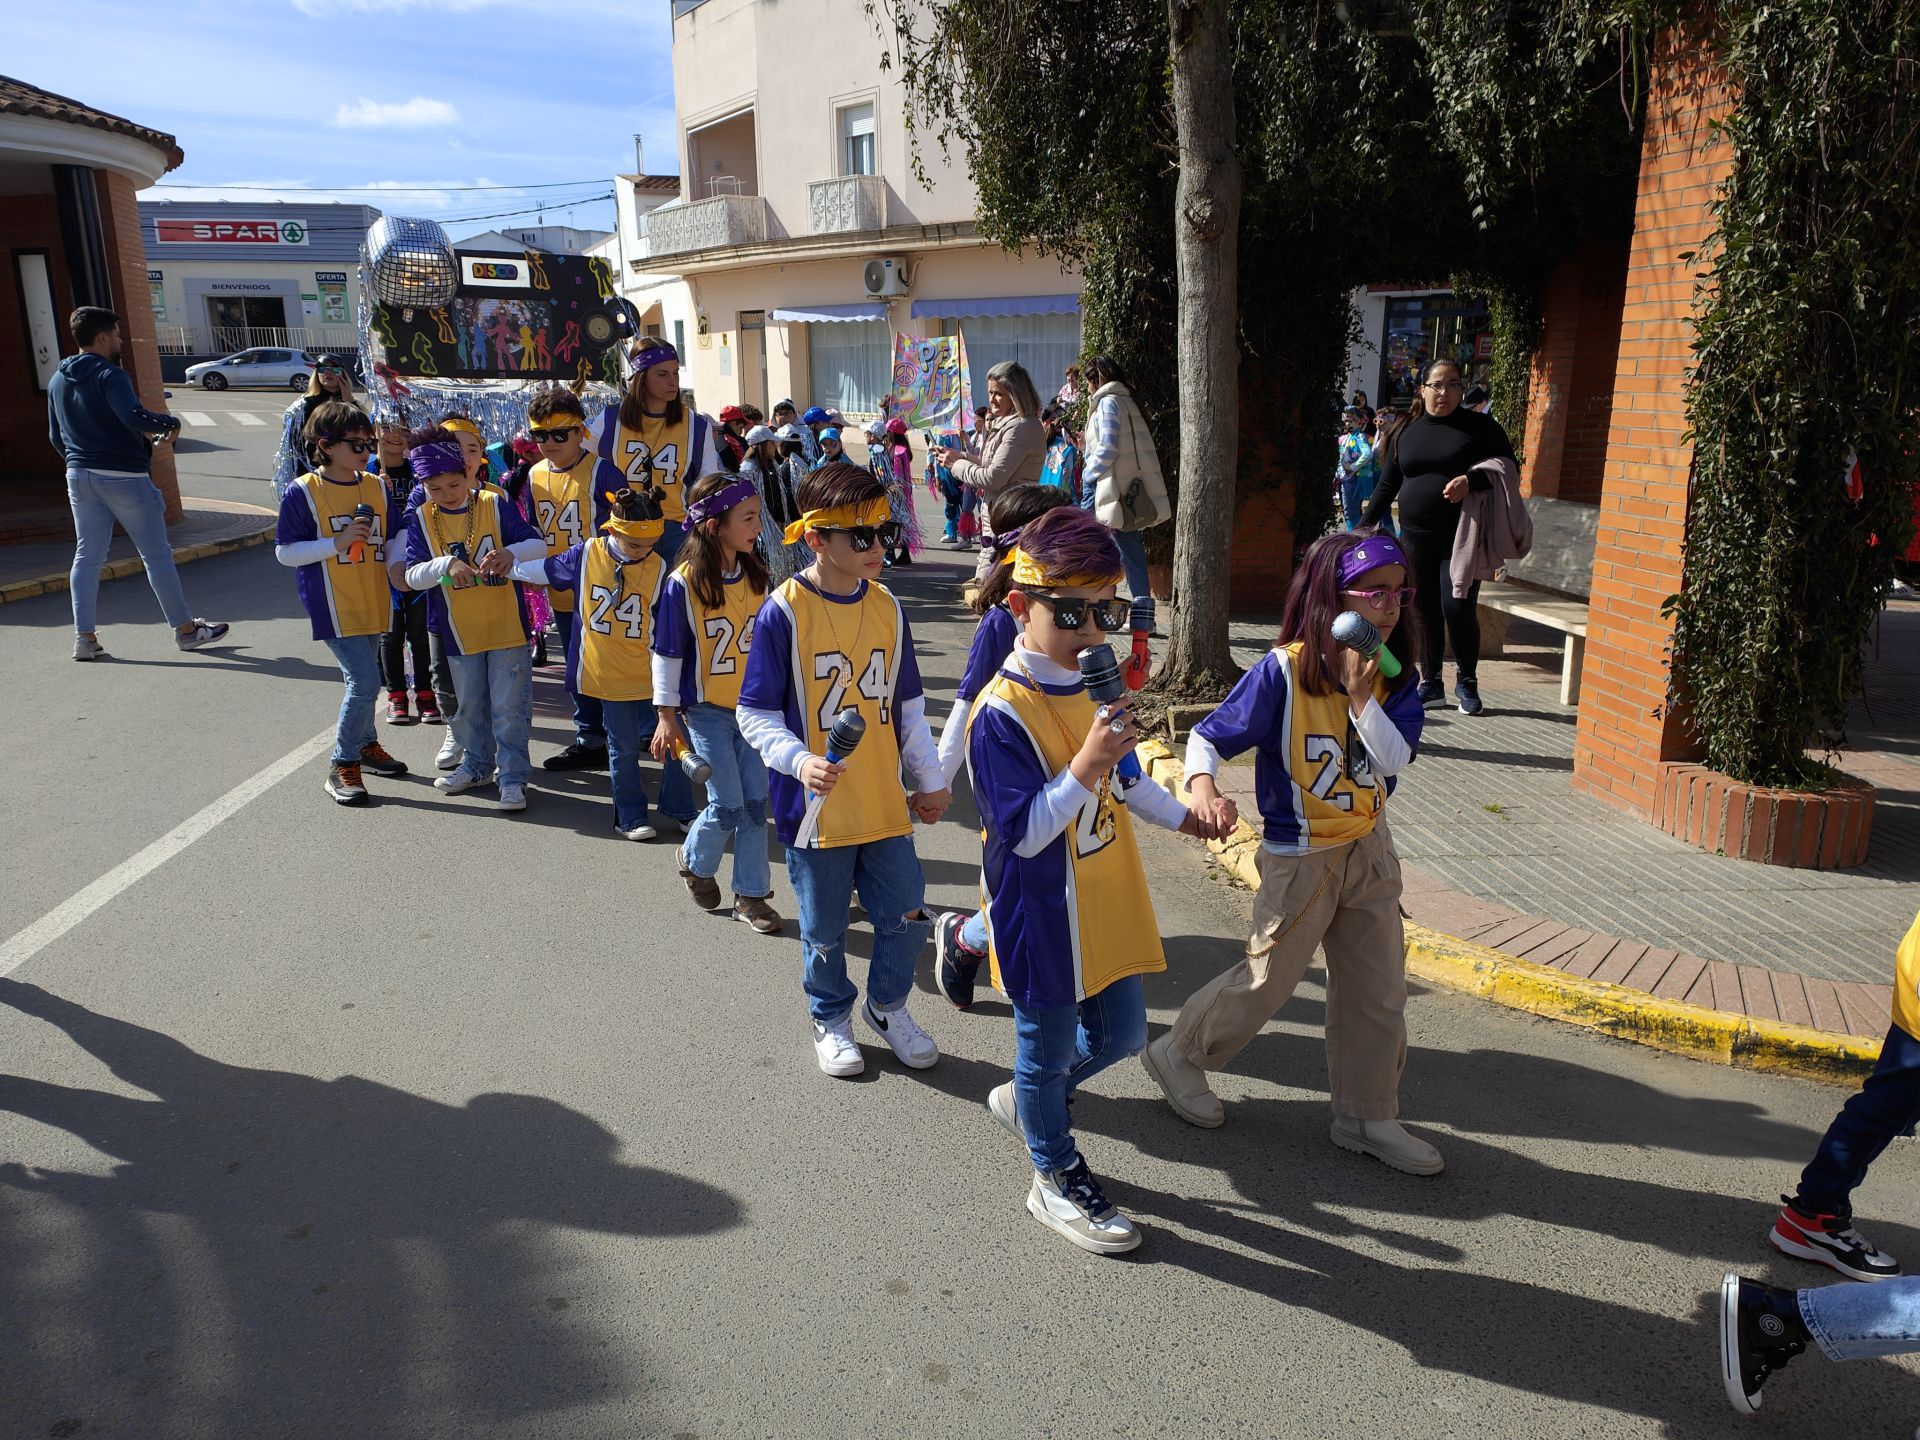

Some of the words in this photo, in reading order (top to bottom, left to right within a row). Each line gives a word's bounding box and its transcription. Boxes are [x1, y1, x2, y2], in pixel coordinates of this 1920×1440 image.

[192, 225, 276, 239] SPAR
[316, 273, 346, 281] OFERTA
[472, 263, 518, 280] DISCO
[627, 440, 678, 484] 24
[538, 501, 583, 546] 24
[589, 584, 643, 639] 24
[814, 649, 889, 732] 24
